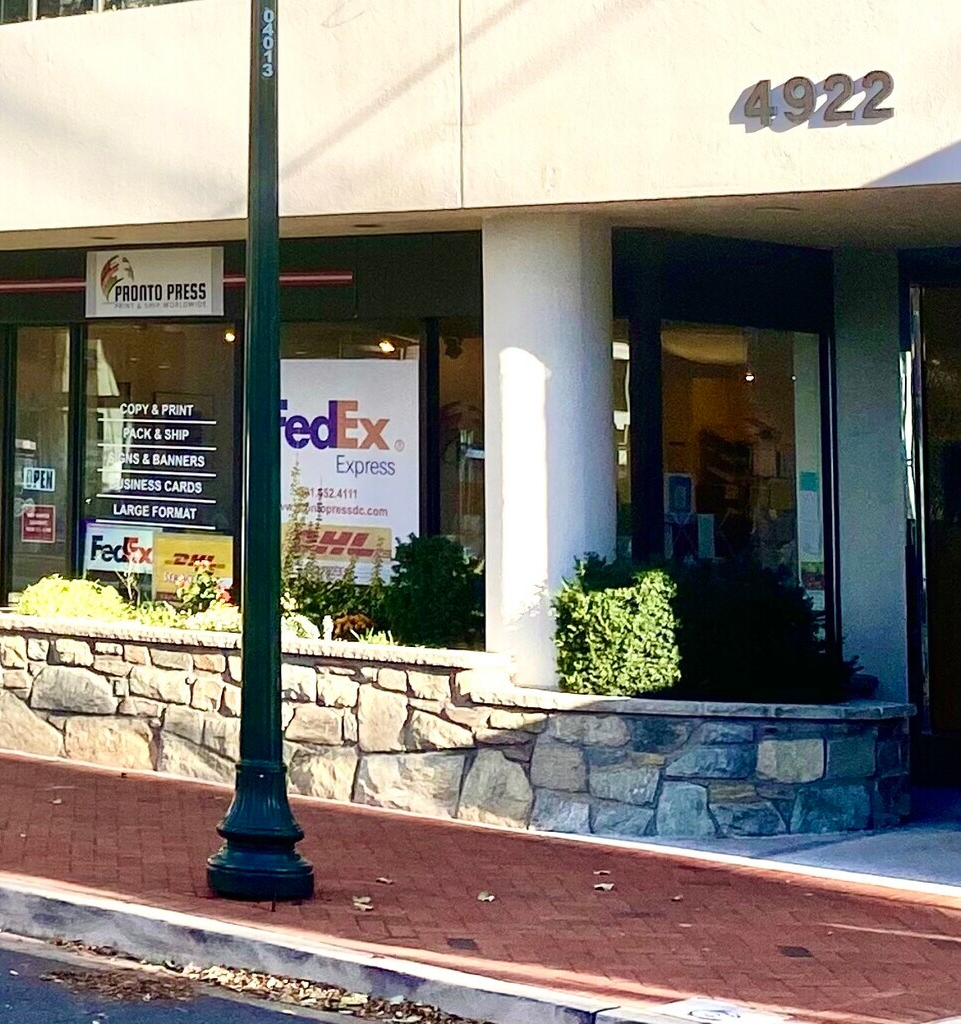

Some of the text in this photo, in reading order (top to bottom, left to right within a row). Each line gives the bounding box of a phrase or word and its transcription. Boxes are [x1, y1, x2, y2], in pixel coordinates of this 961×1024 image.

[262, 8, 275, 77] 04013
[744, 70, 895, 127] 4922
[114, 283, 207, 302] PRONTO PRESS
[120, 403, 194, 416] COPY & PRINT
[123, 427, 189, 440] PACK & SHIP
[142, 454, 150, 465] &
[152, 454, 205, 467] BANNERS
[336, 454, 396, 478] Express
[26, 469, 53, 489] OPEN
[113, 478, 203, 494] USINESS CARDS
[113, 504, 197, 519] LARGE FORMAT
